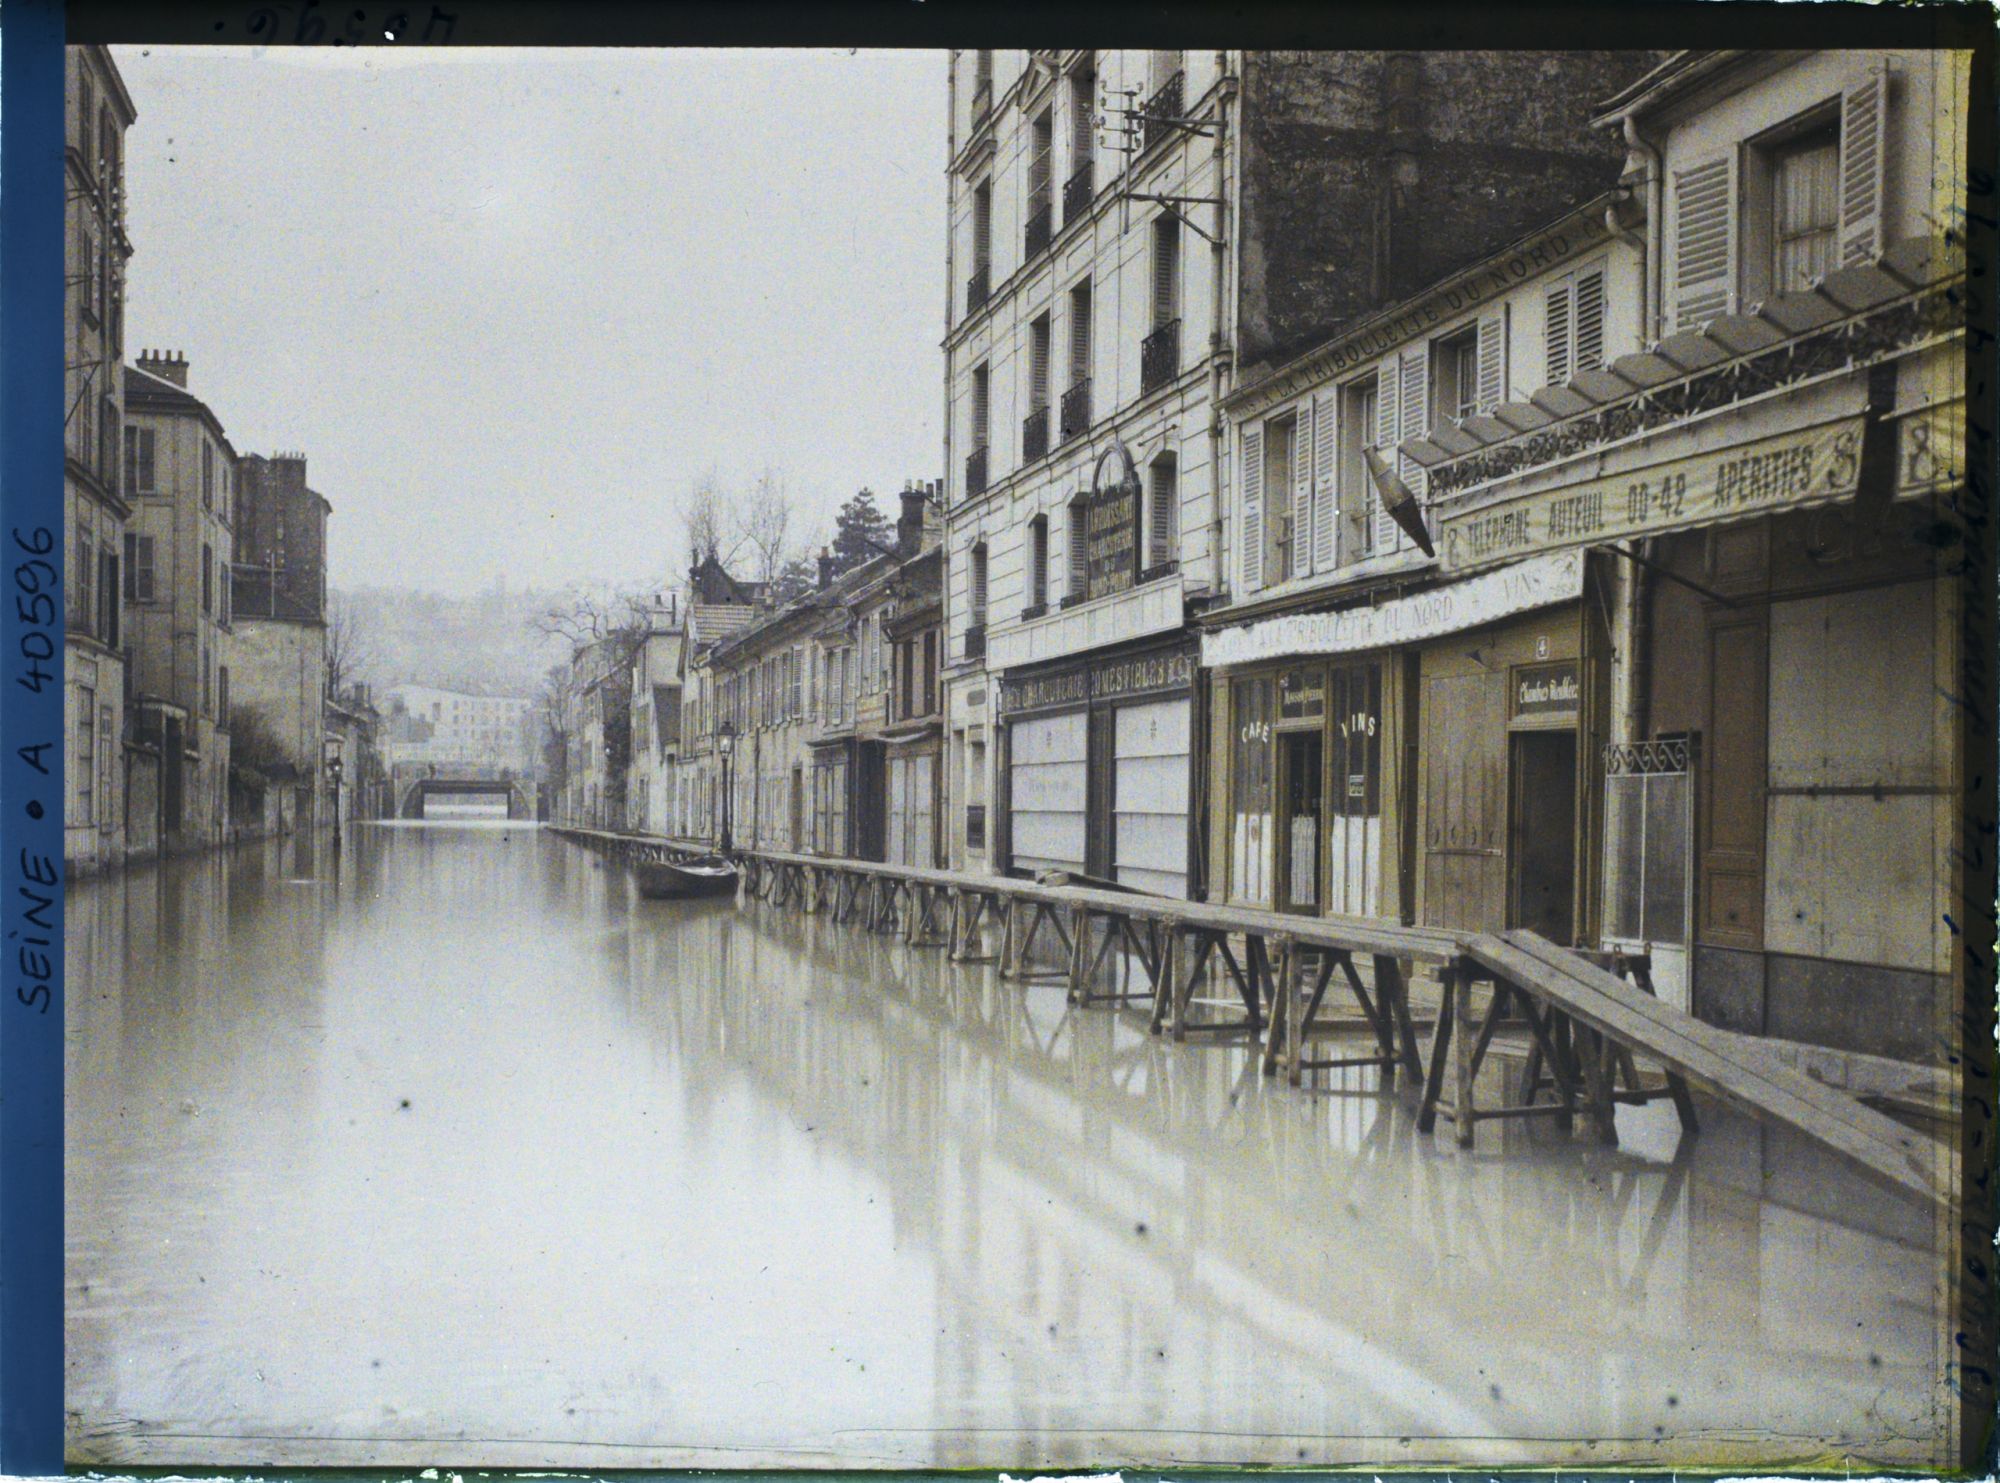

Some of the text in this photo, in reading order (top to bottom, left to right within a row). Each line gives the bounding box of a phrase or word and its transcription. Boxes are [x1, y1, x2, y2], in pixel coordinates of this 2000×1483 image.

[1301, 304, 1439, 385] TRIBOULETTE
[1445, 280, 1481, 310] DU
[1487, 235, 1570, 289] NORD
[1548, 491, 1605, 540] AUTEUIL
[1412, 597, 1452, 628] NORD
[1341, 712, 1375, 737] VINS
[12, 526, 58, 1014] SEINE A 40596
